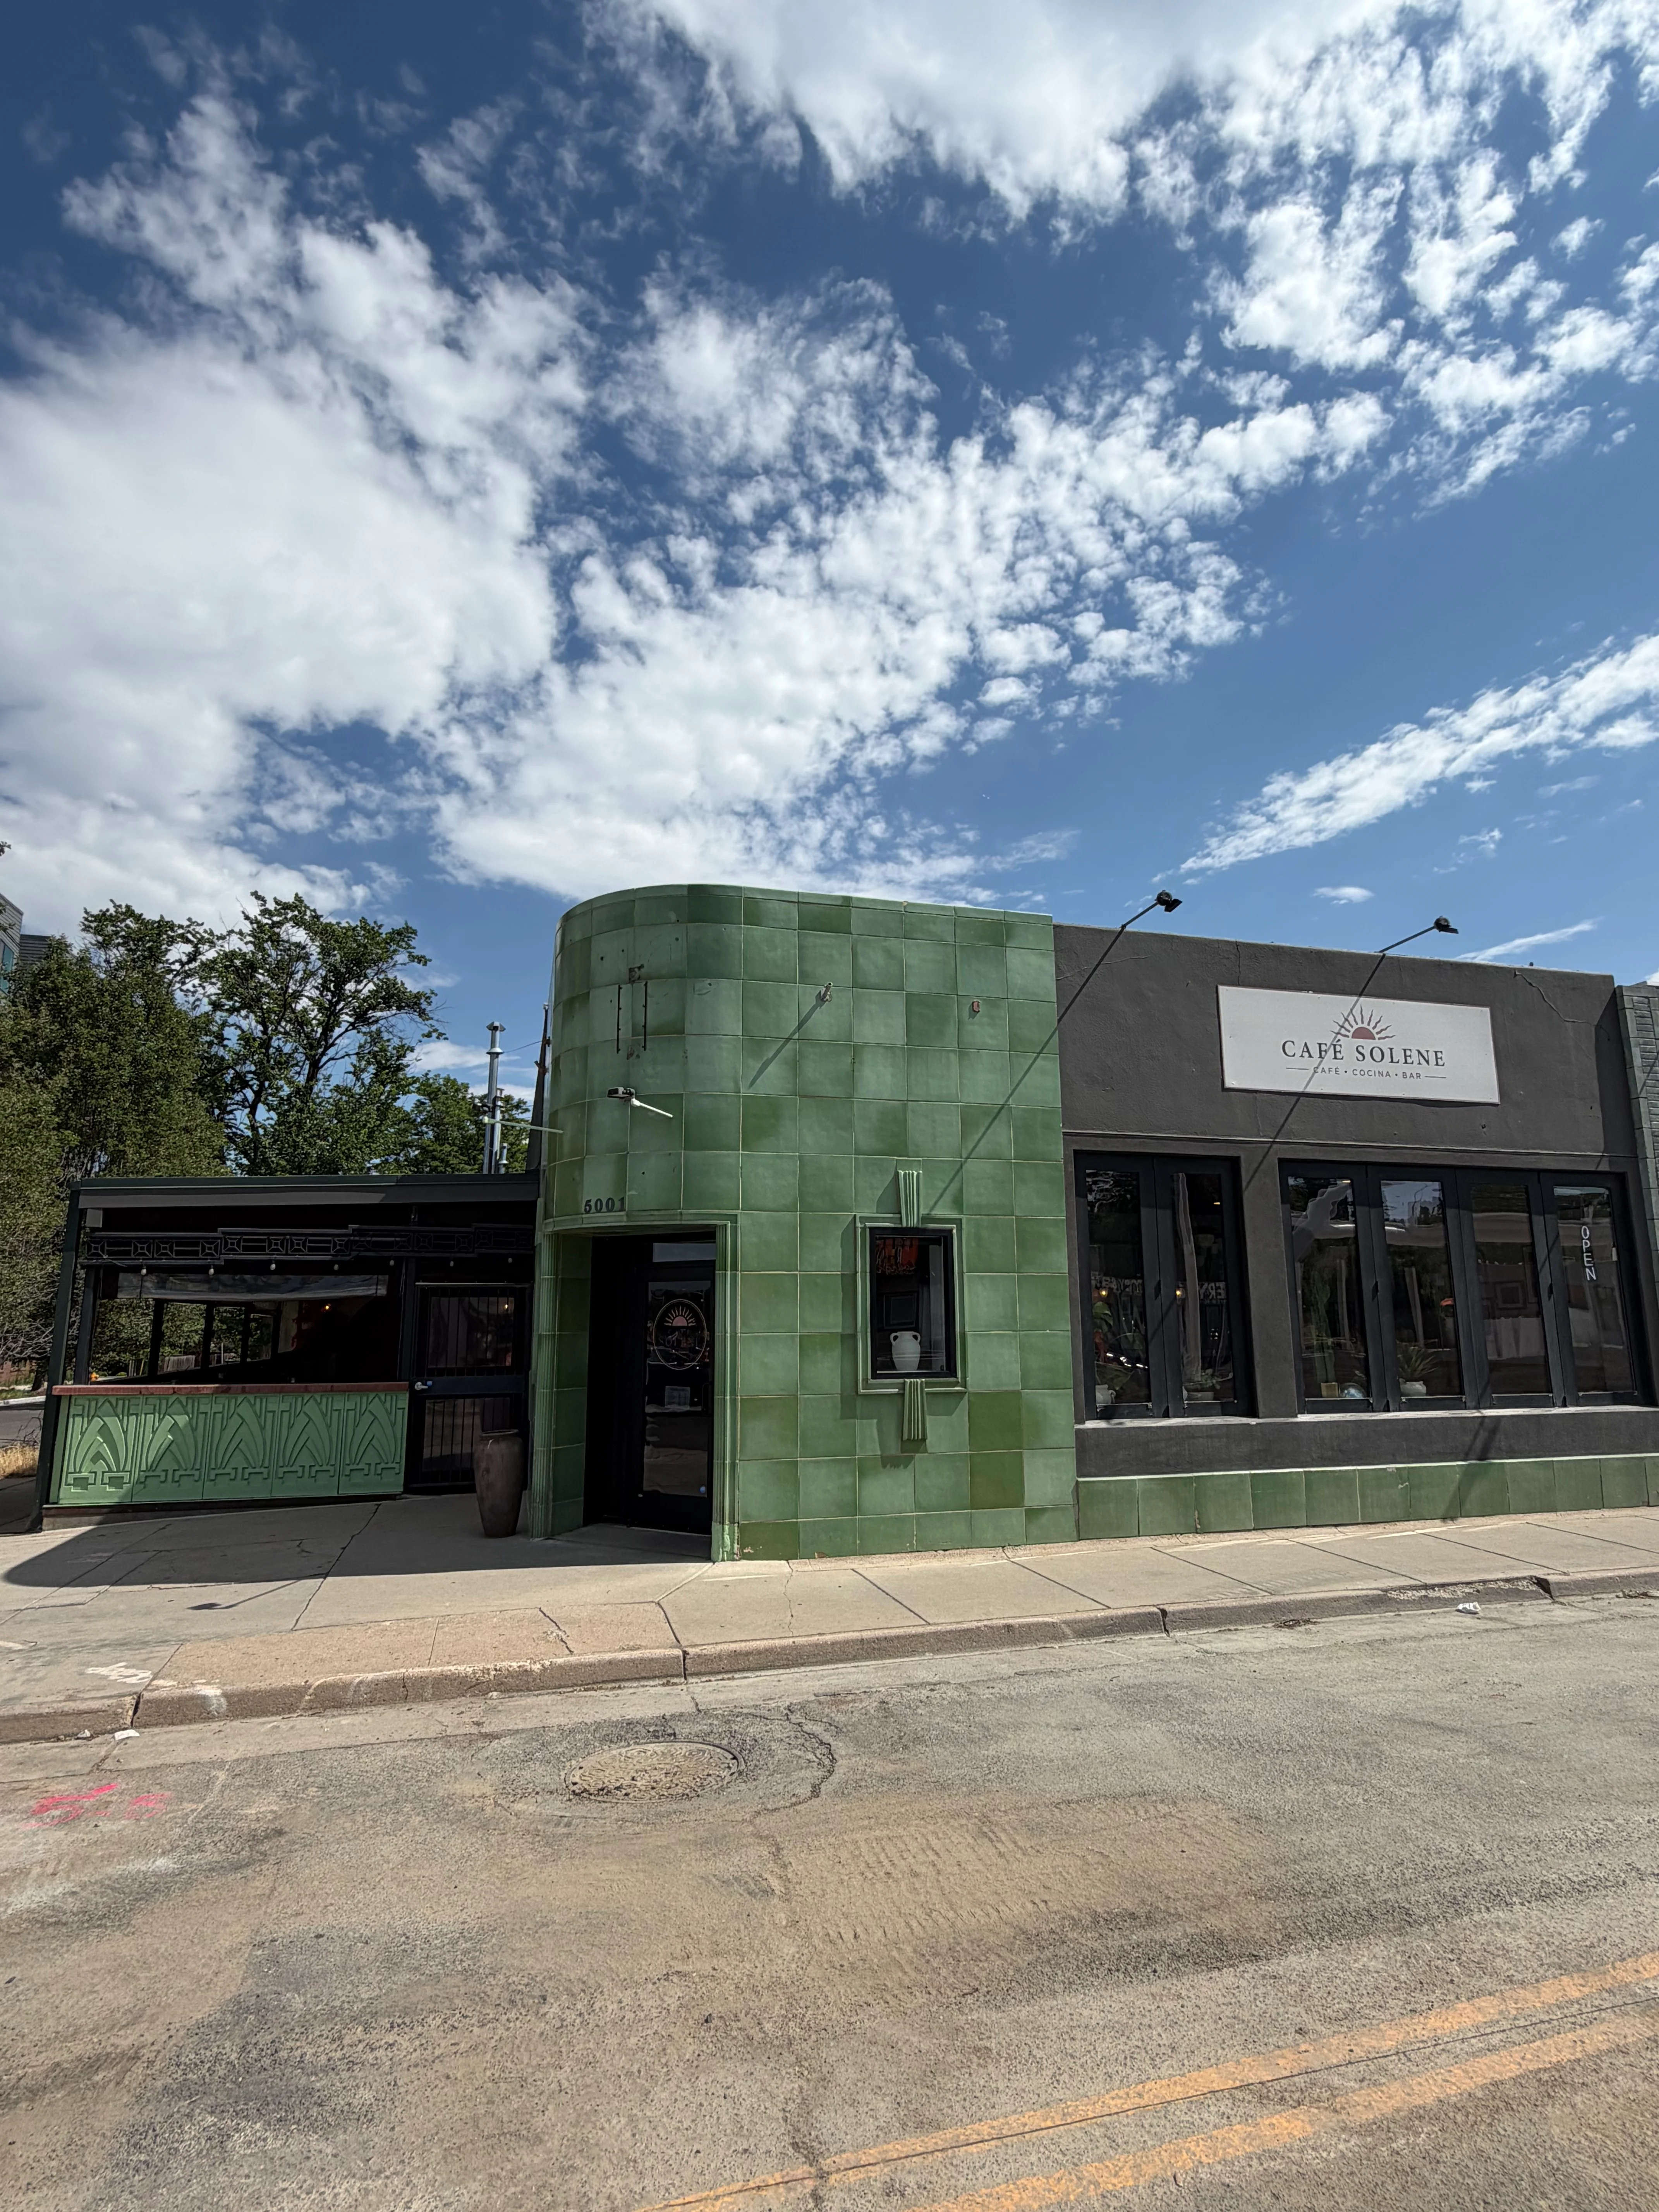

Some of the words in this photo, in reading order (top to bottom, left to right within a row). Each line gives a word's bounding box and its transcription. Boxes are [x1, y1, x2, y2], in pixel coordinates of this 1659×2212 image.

[1282, 1039, 1344, 1060] CAFÉ
[1355, 1045, 1445, 1066] SOLENE
[1313, 1066, 1340, 1075] CAFÉ
[1352, 1069, 1391, 1078] COCINA
[584, 1196, 625, 1213] 5001
[1581, 1225, 1596, 1281] OPEN
